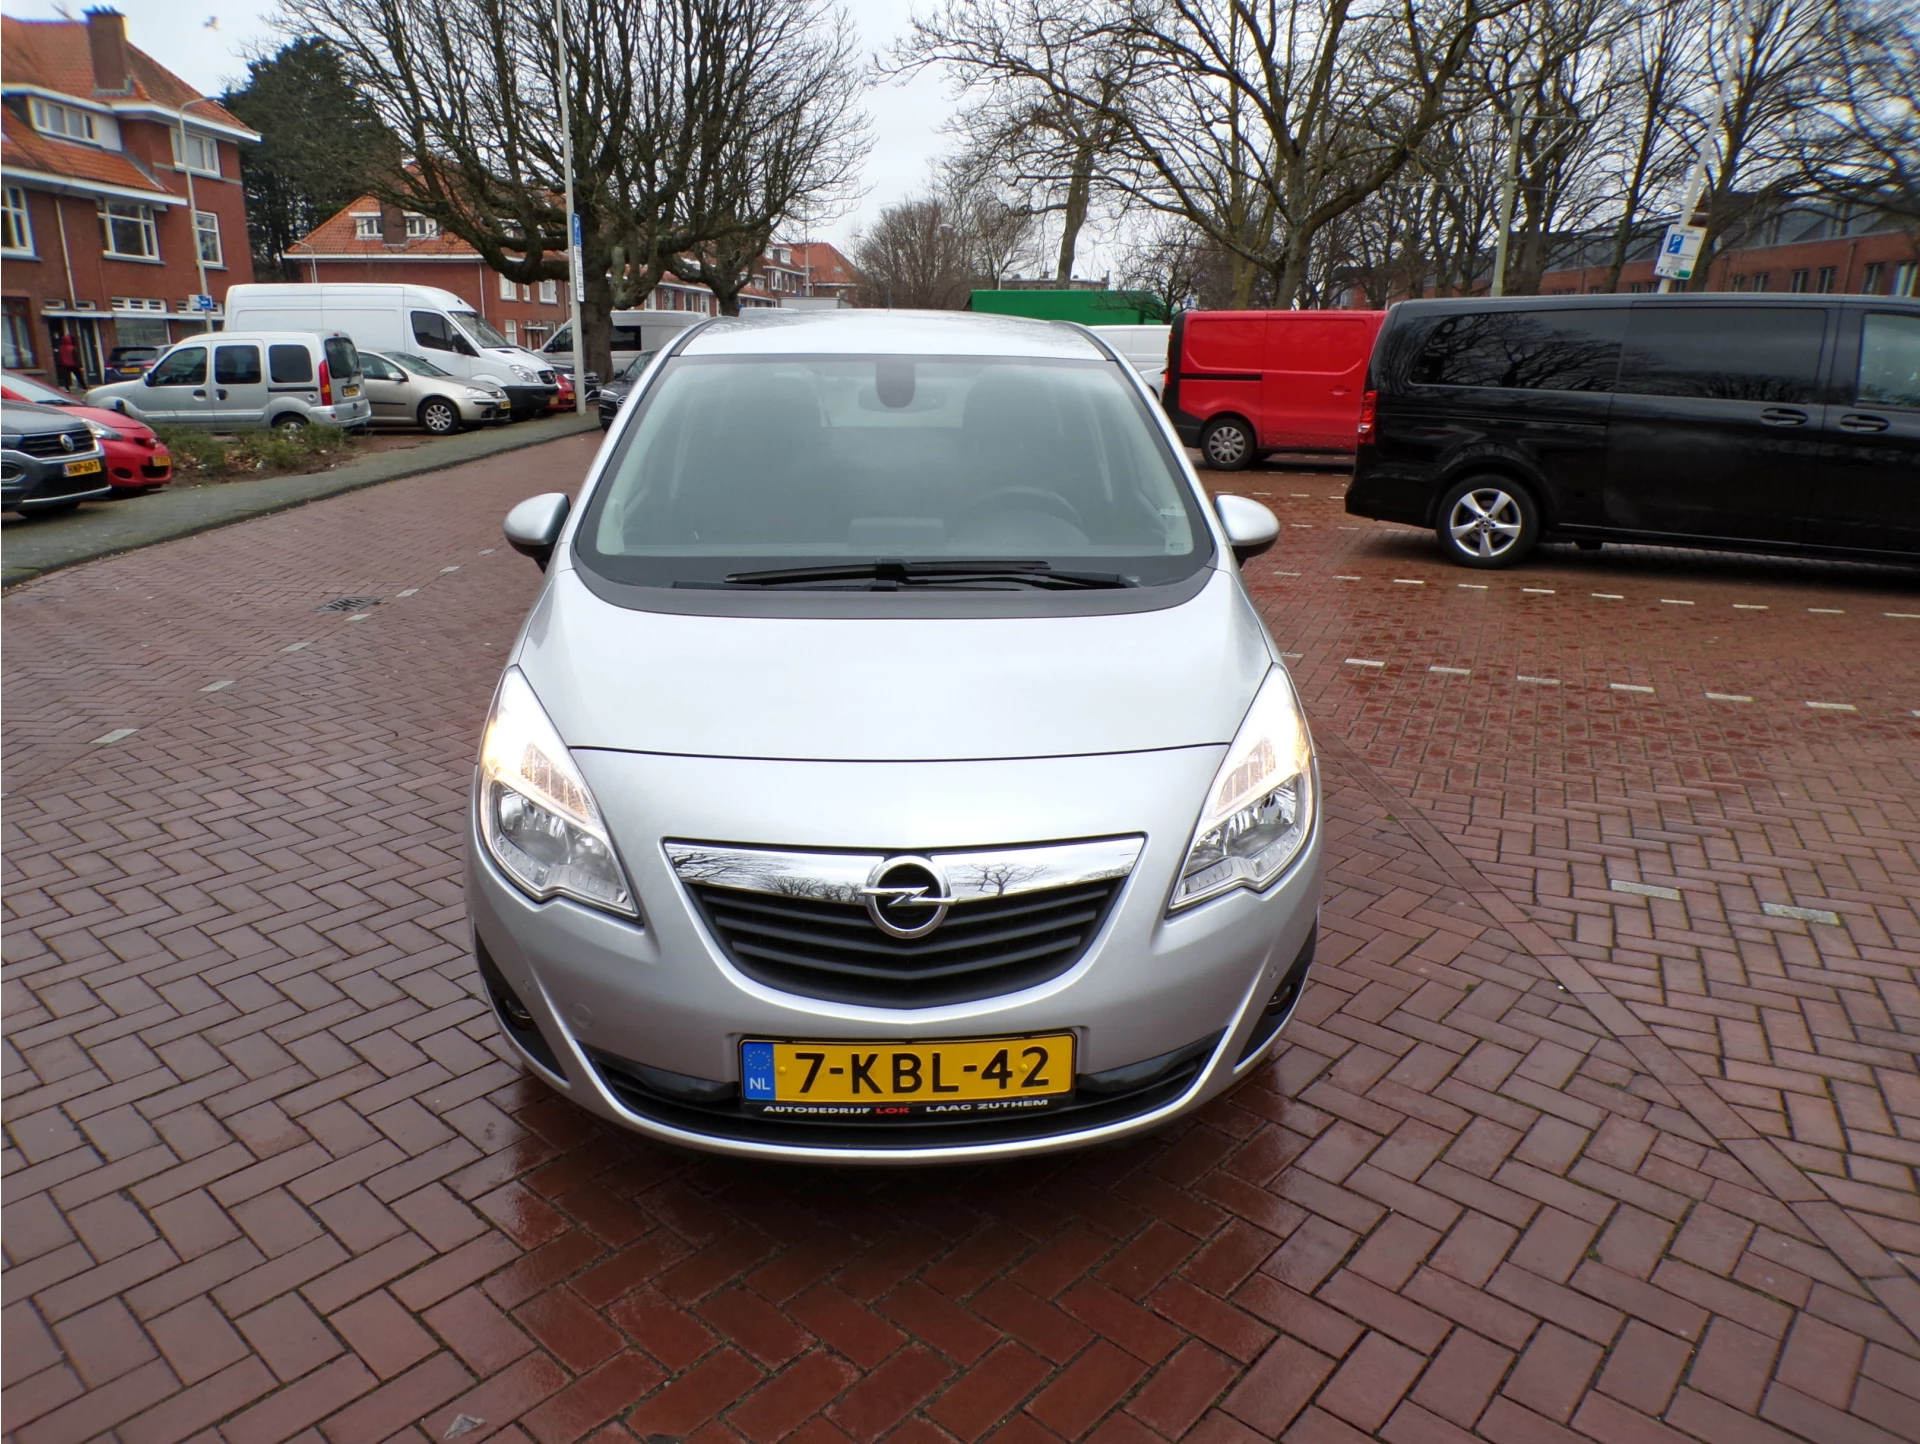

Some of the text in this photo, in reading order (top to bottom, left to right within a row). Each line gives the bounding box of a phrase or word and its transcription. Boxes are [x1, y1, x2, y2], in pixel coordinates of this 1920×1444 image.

[795, 1046, 1050, 1094] 7-KBL-42
[750, 1077, 771, 1091] NL
[763, 1105, 871, 1115] AUTOBEDRIJF
[977, 1099, 1049, 1111] ZUTHEM
